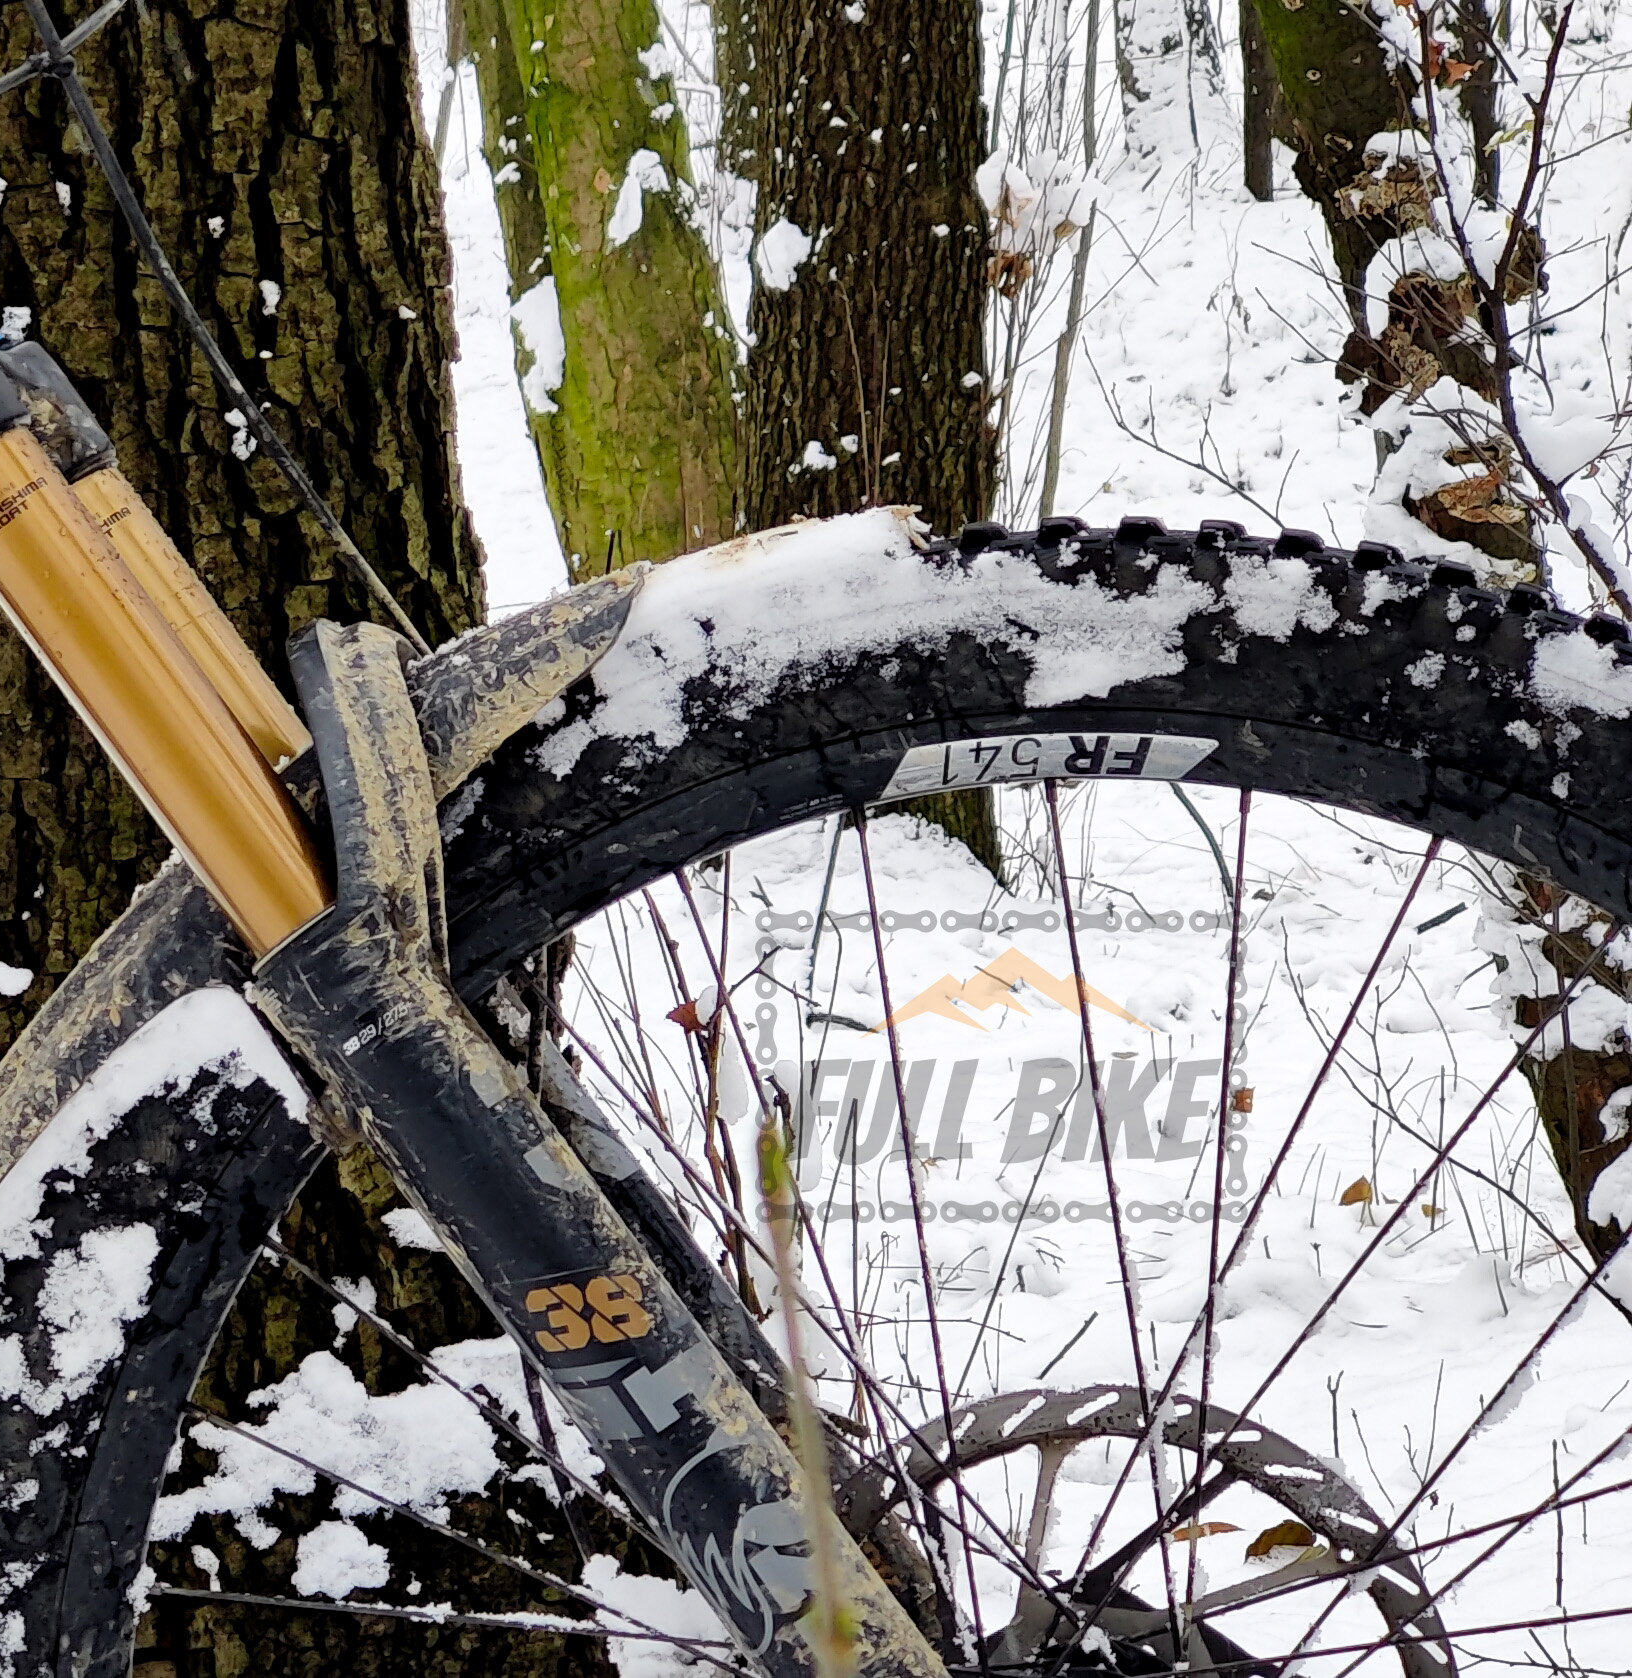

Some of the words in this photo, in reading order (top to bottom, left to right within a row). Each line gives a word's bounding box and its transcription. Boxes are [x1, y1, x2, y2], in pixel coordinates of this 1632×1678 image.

[100, 507, 131, 529] HIMA
[942, 737, 1042, 785] 541
[1065, 735, 1153, 775] FR
[525, 1274, 651, 1353] 38
